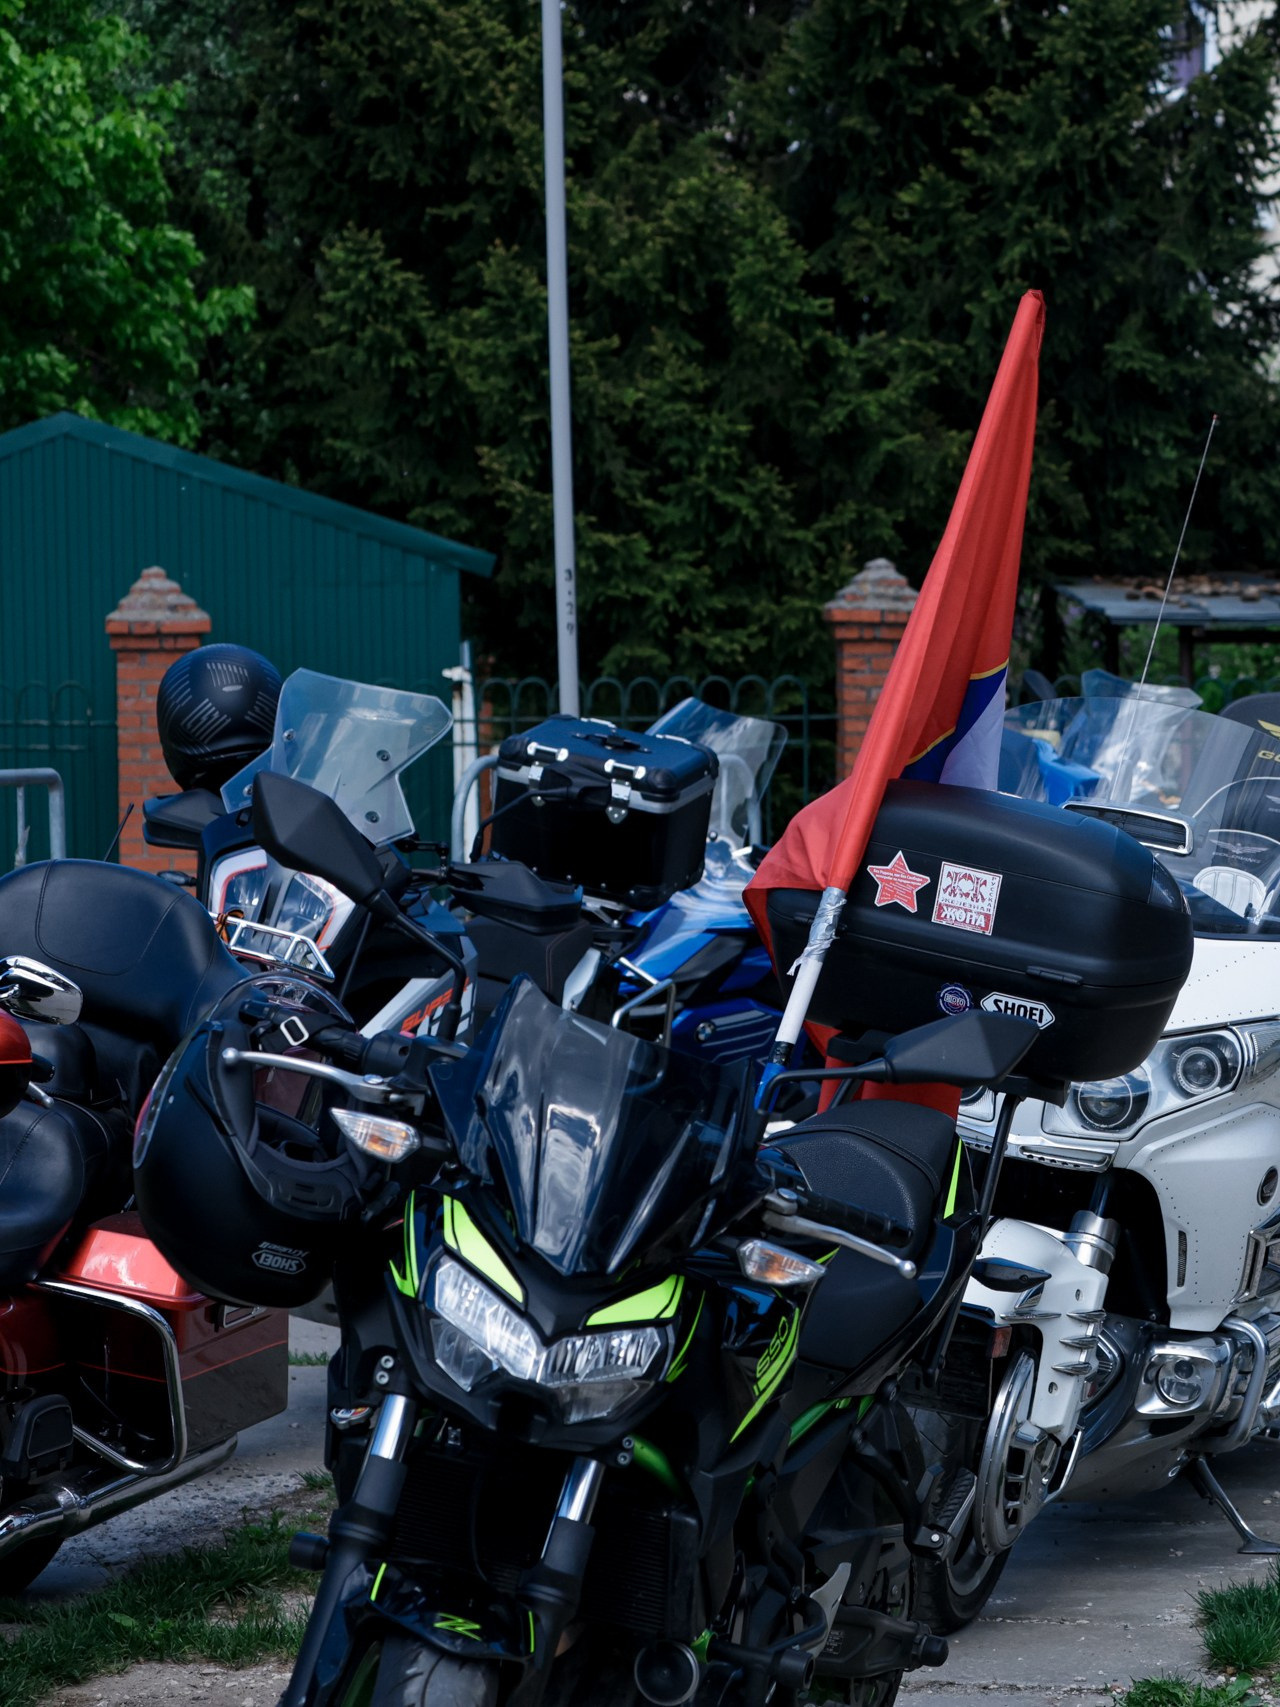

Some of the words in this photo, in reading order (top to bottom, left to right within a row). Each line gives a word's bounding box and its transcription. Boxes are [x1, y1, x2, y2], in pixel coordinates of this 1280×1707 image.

[940, 905, 986, 928] ЖОПА
[400, 976, 470, 1033] SUPE
[993, 998, 1045, 1024] SHOEI
[259, 1252, 300, 1272] SHOEI
